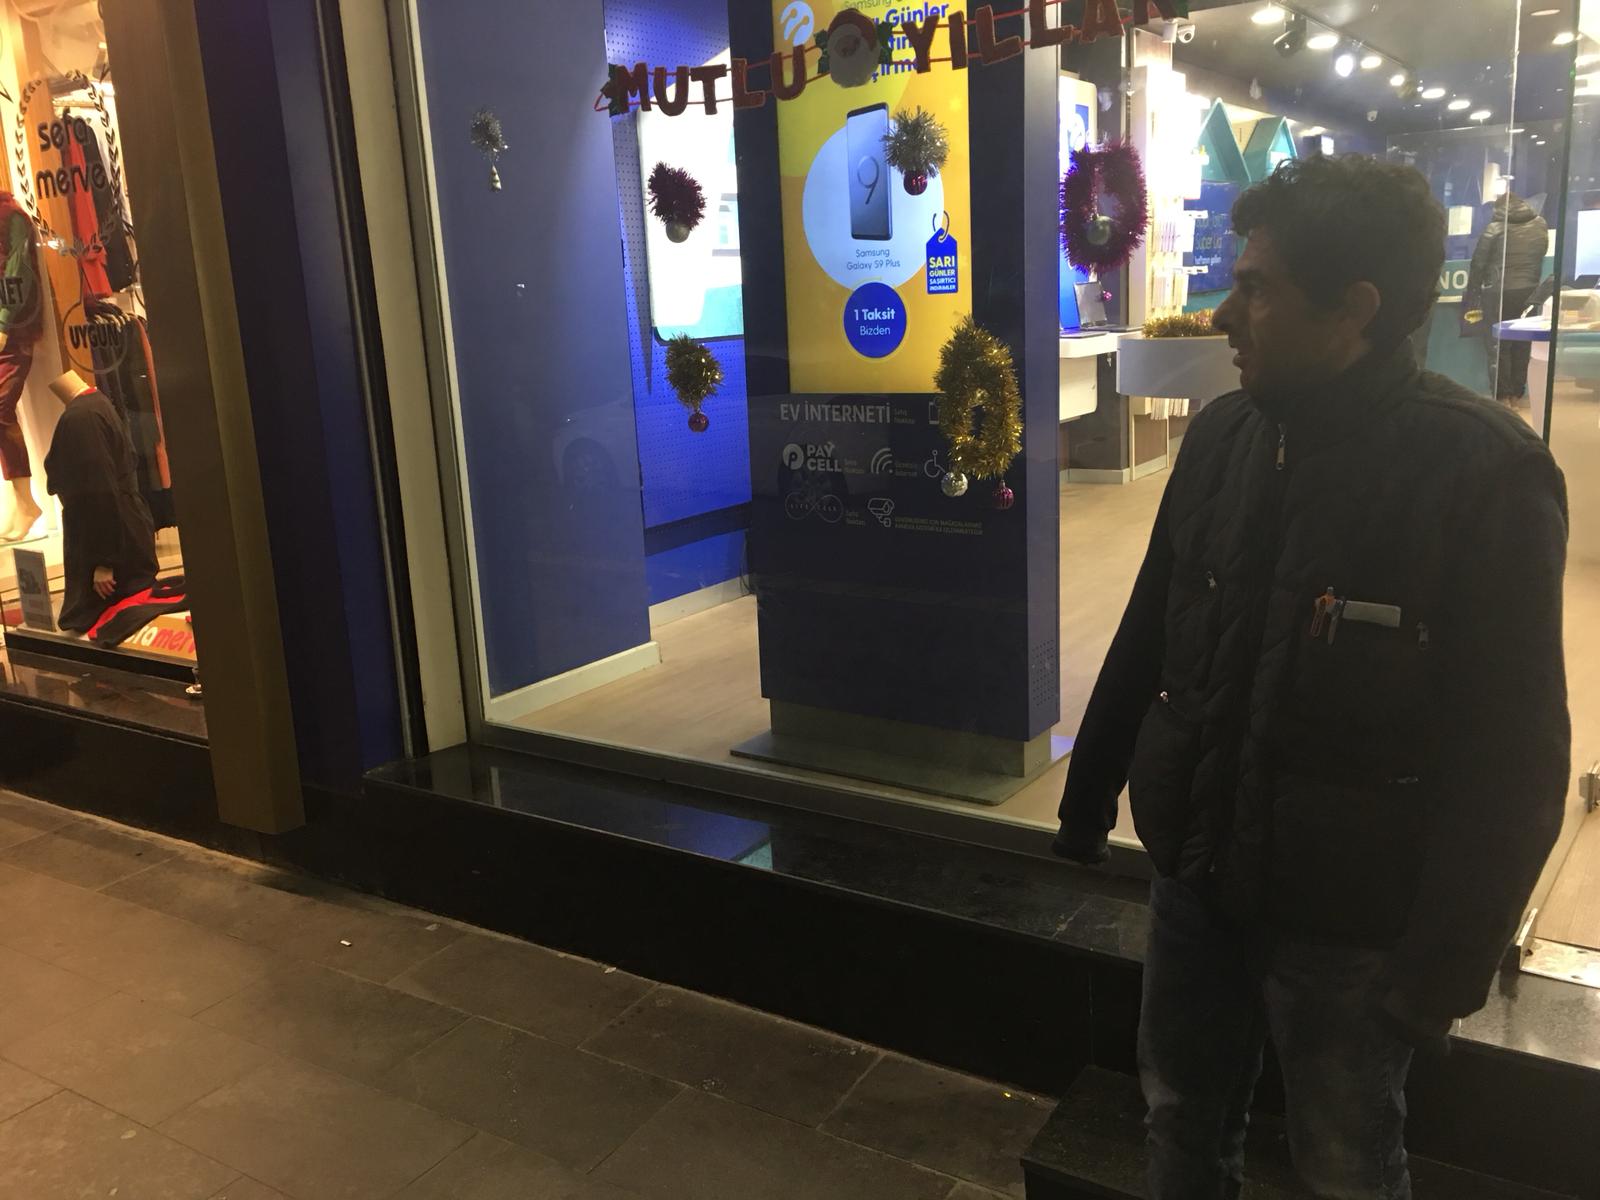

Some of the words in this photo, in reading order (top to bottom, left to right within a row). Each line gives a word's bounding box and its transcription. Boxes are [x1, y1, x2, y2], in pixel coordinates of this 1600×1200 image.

[614, 45, 806, 116] MUTLU
[36, 164, 106, 199] merve
[856, 249, 890, 258] Samsung
[847, 261, 873, 270] Galaxy
[874, 259, 883, 269] S9
[885, 258, 901, 268] Plus
[929, 256, 955, 269] SARI
[854, 309, 859, 321] 1
[862, 307, 895, 321] Taksit
[69, 325, 121, 349] UYGUN
[860, 324, 891, 336] Bizden
[780, 403, 800, 422] EV
[805, 400, 890, 424] İNTERNETİ
[807, 442, 835, 457] PAY
[807, 457, 842, 473] CELL
